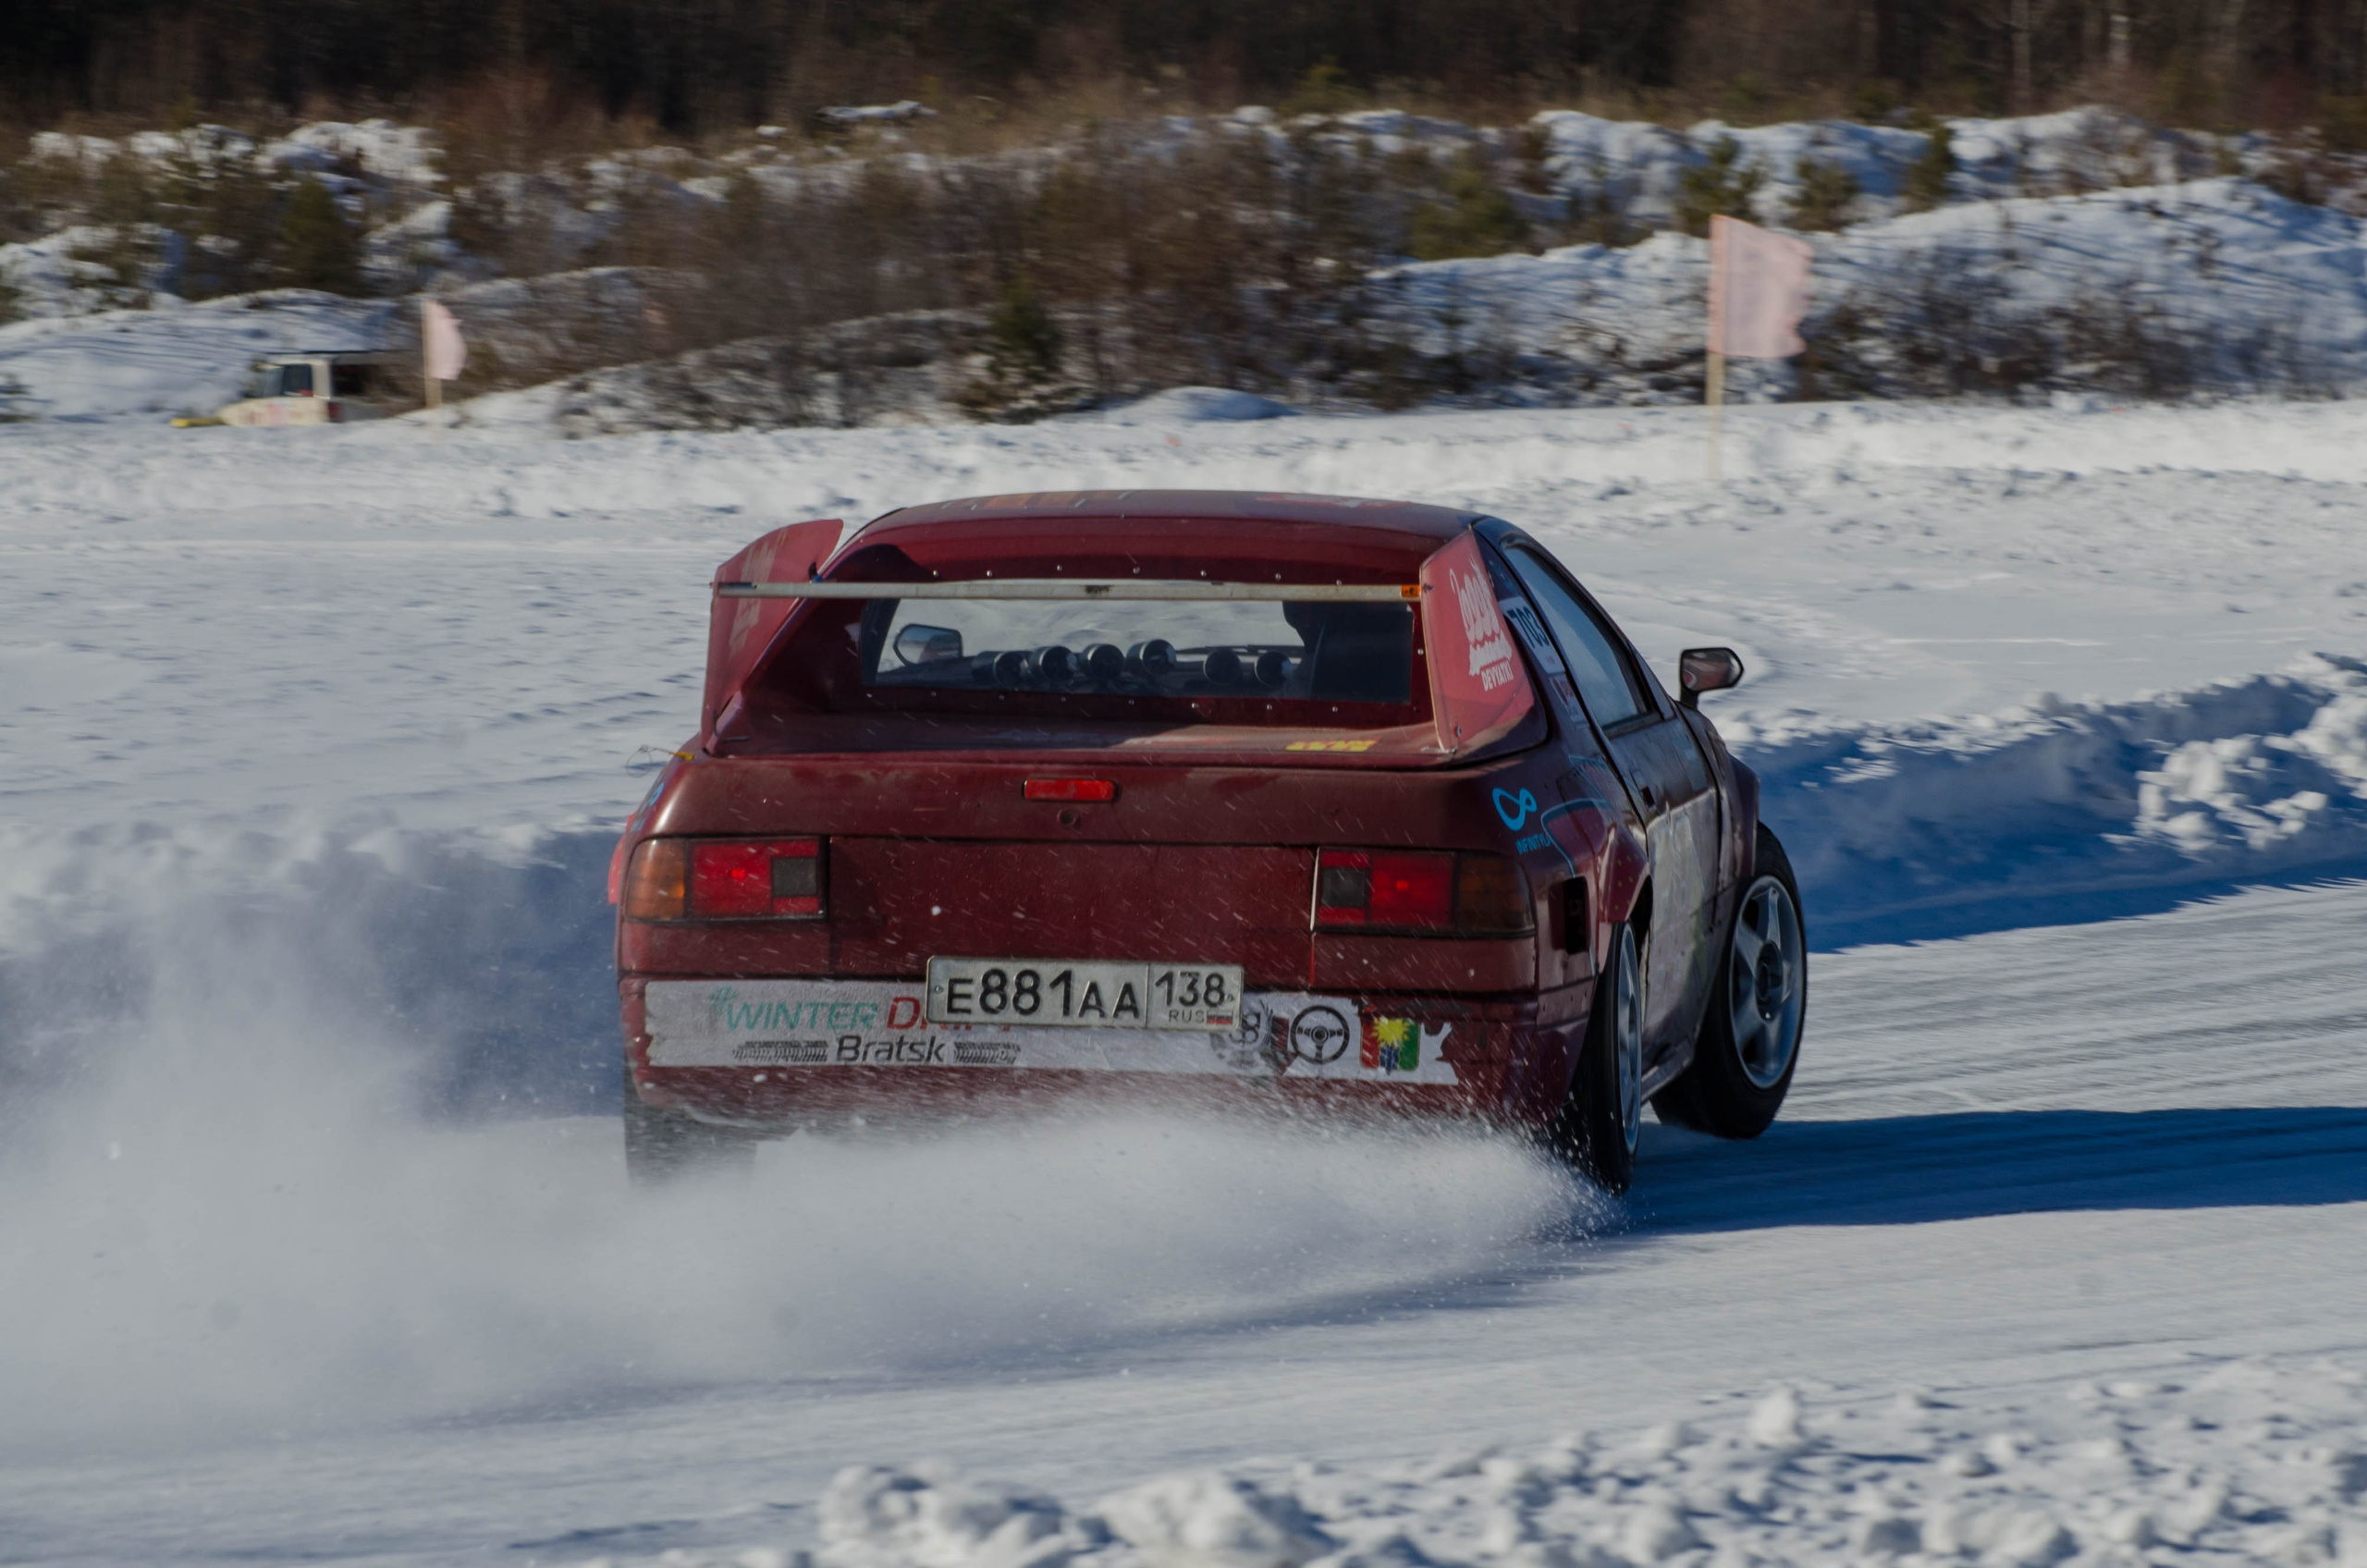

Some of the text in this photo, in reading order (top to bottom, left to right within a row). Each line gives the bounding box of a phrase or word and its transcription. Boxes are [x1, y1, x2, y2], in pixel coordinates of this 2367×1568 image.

[1506, 606, 1551, 649] 703
[946, 968, 1142, 1018] E881AA
[1154, 970, 1225, 1008] 138
[725, 1000, 878, 1031] WINTER
[1168, 1009, 1204, 1023] RUS
[836, 1035, 947, 1063] Bratsk
